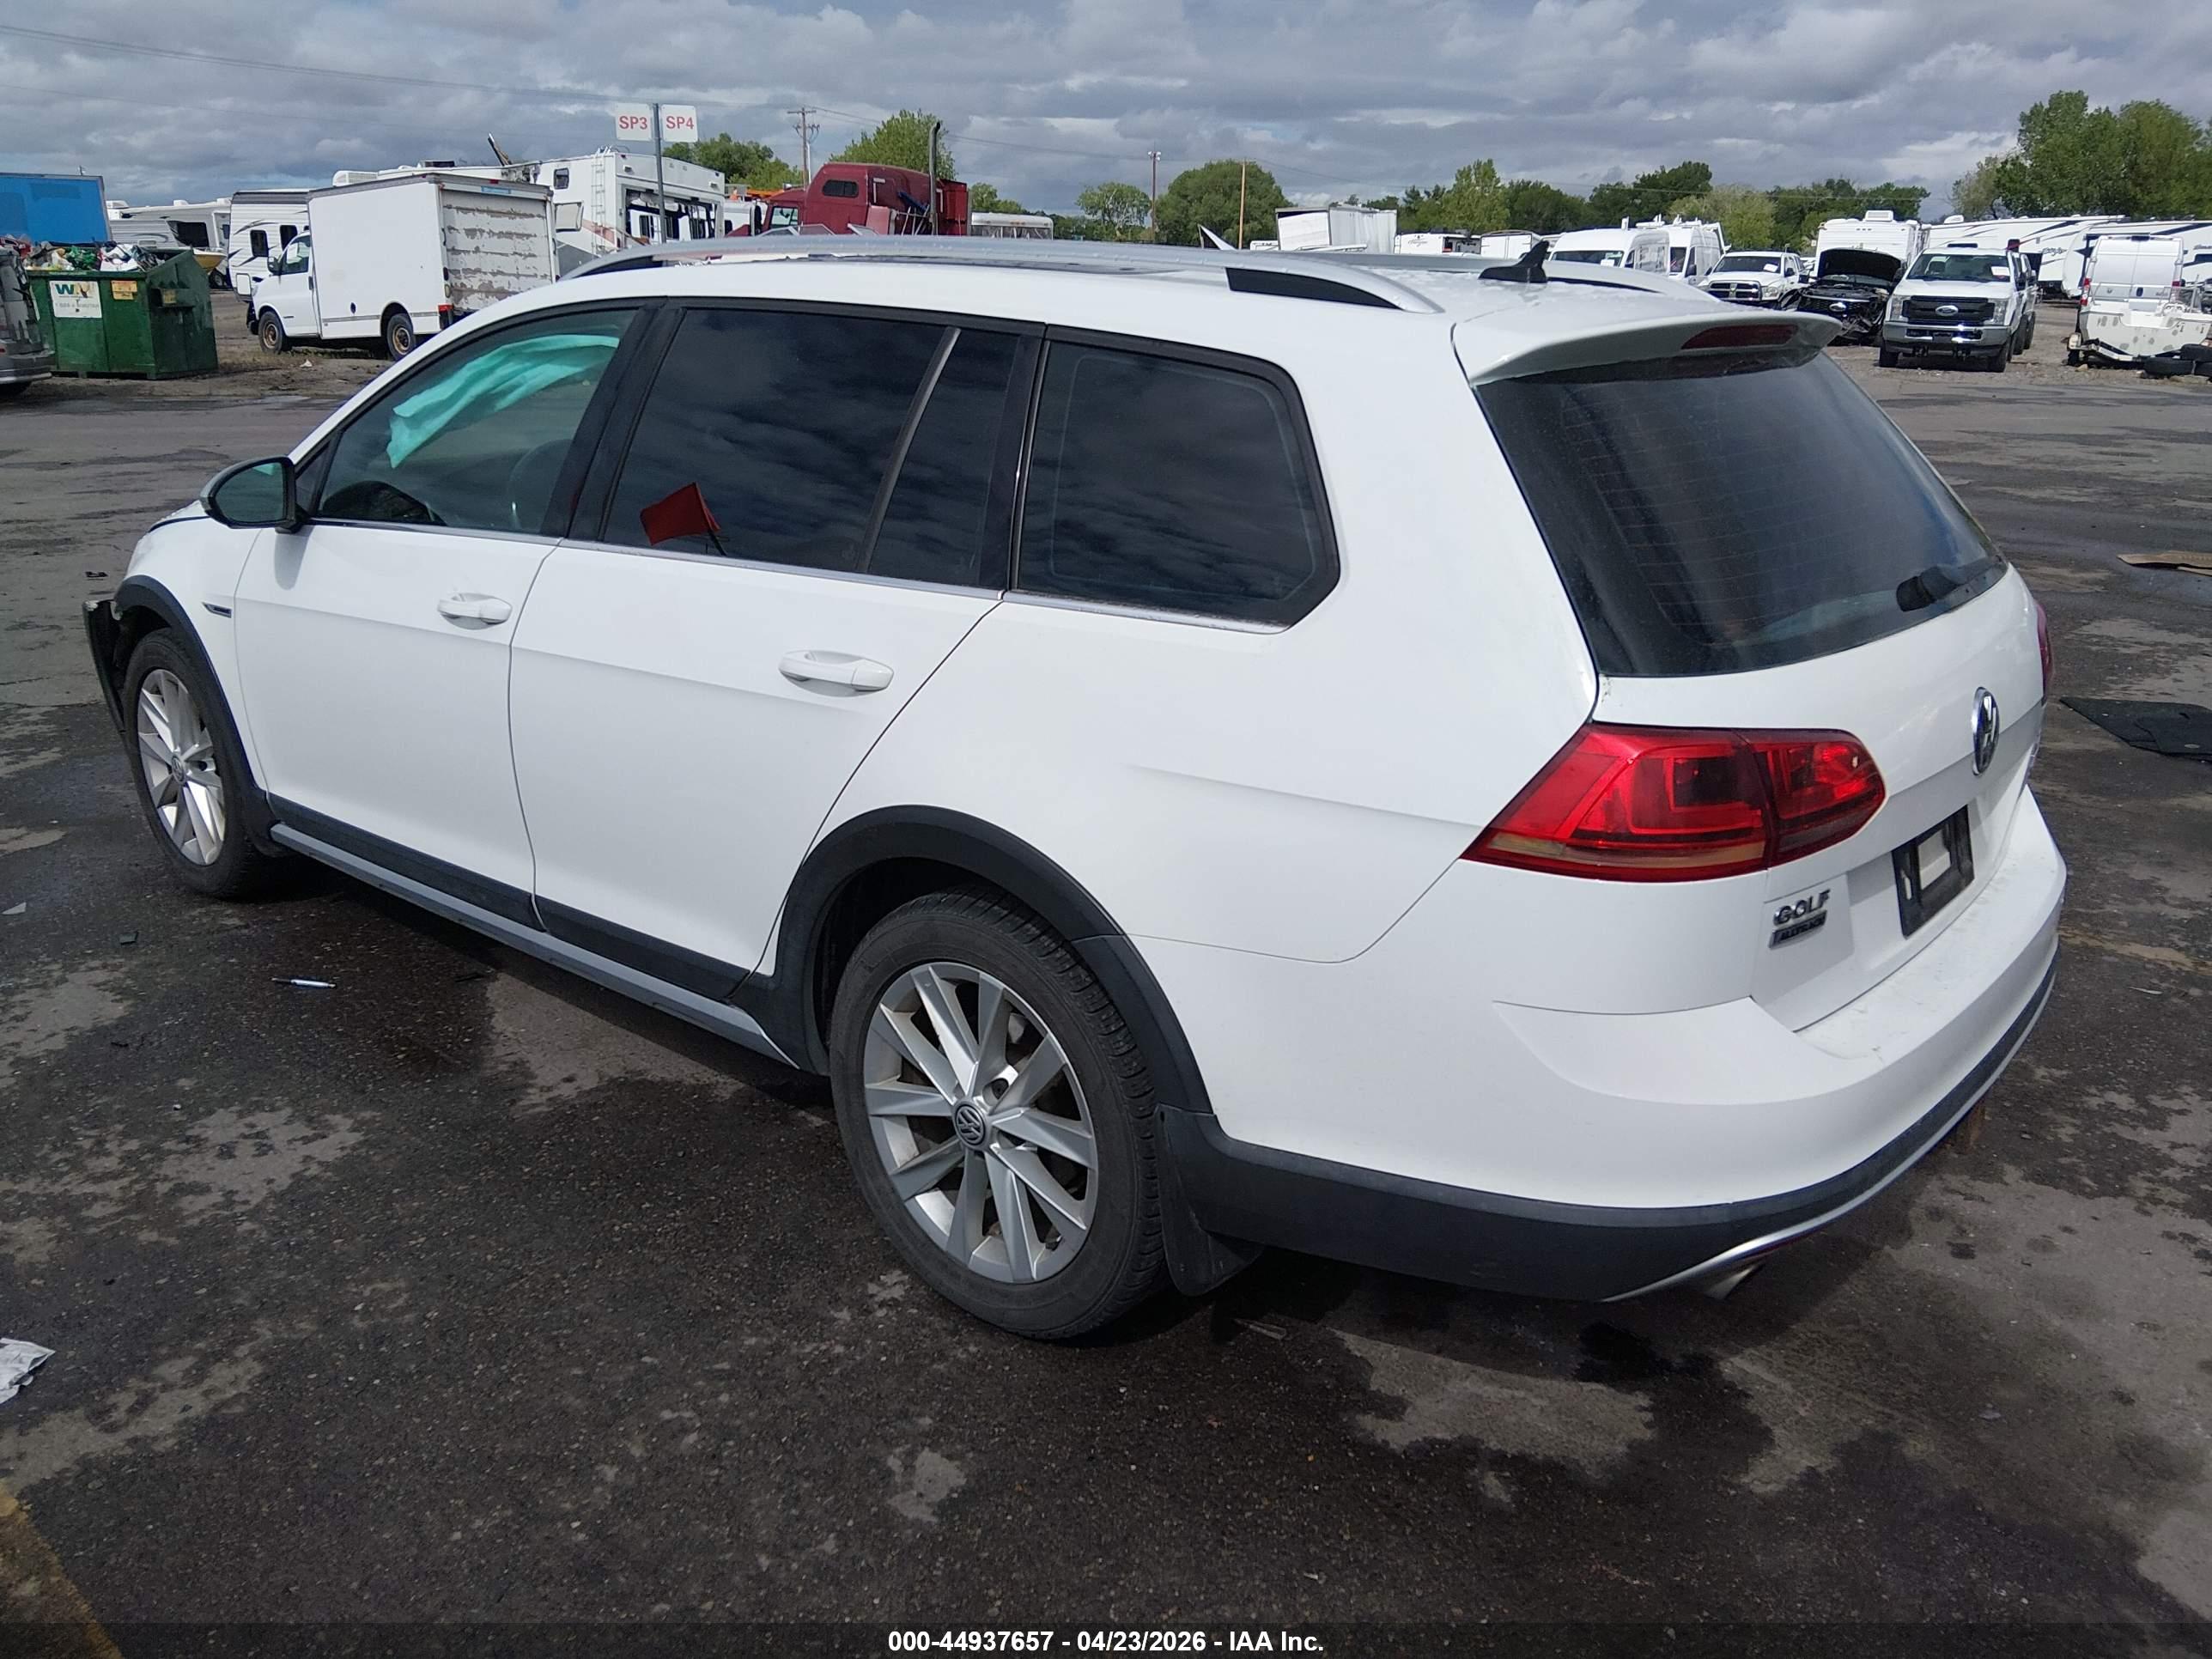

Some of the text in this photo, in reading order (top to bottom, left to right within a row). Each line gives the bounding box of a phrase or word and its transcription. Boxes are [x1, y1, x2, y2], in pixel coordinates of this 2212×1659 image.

[619, 115, 648, 131] SP3
[665, 115, 695, 131] SP4
[1773, 888, 1831, 926] GOLF
